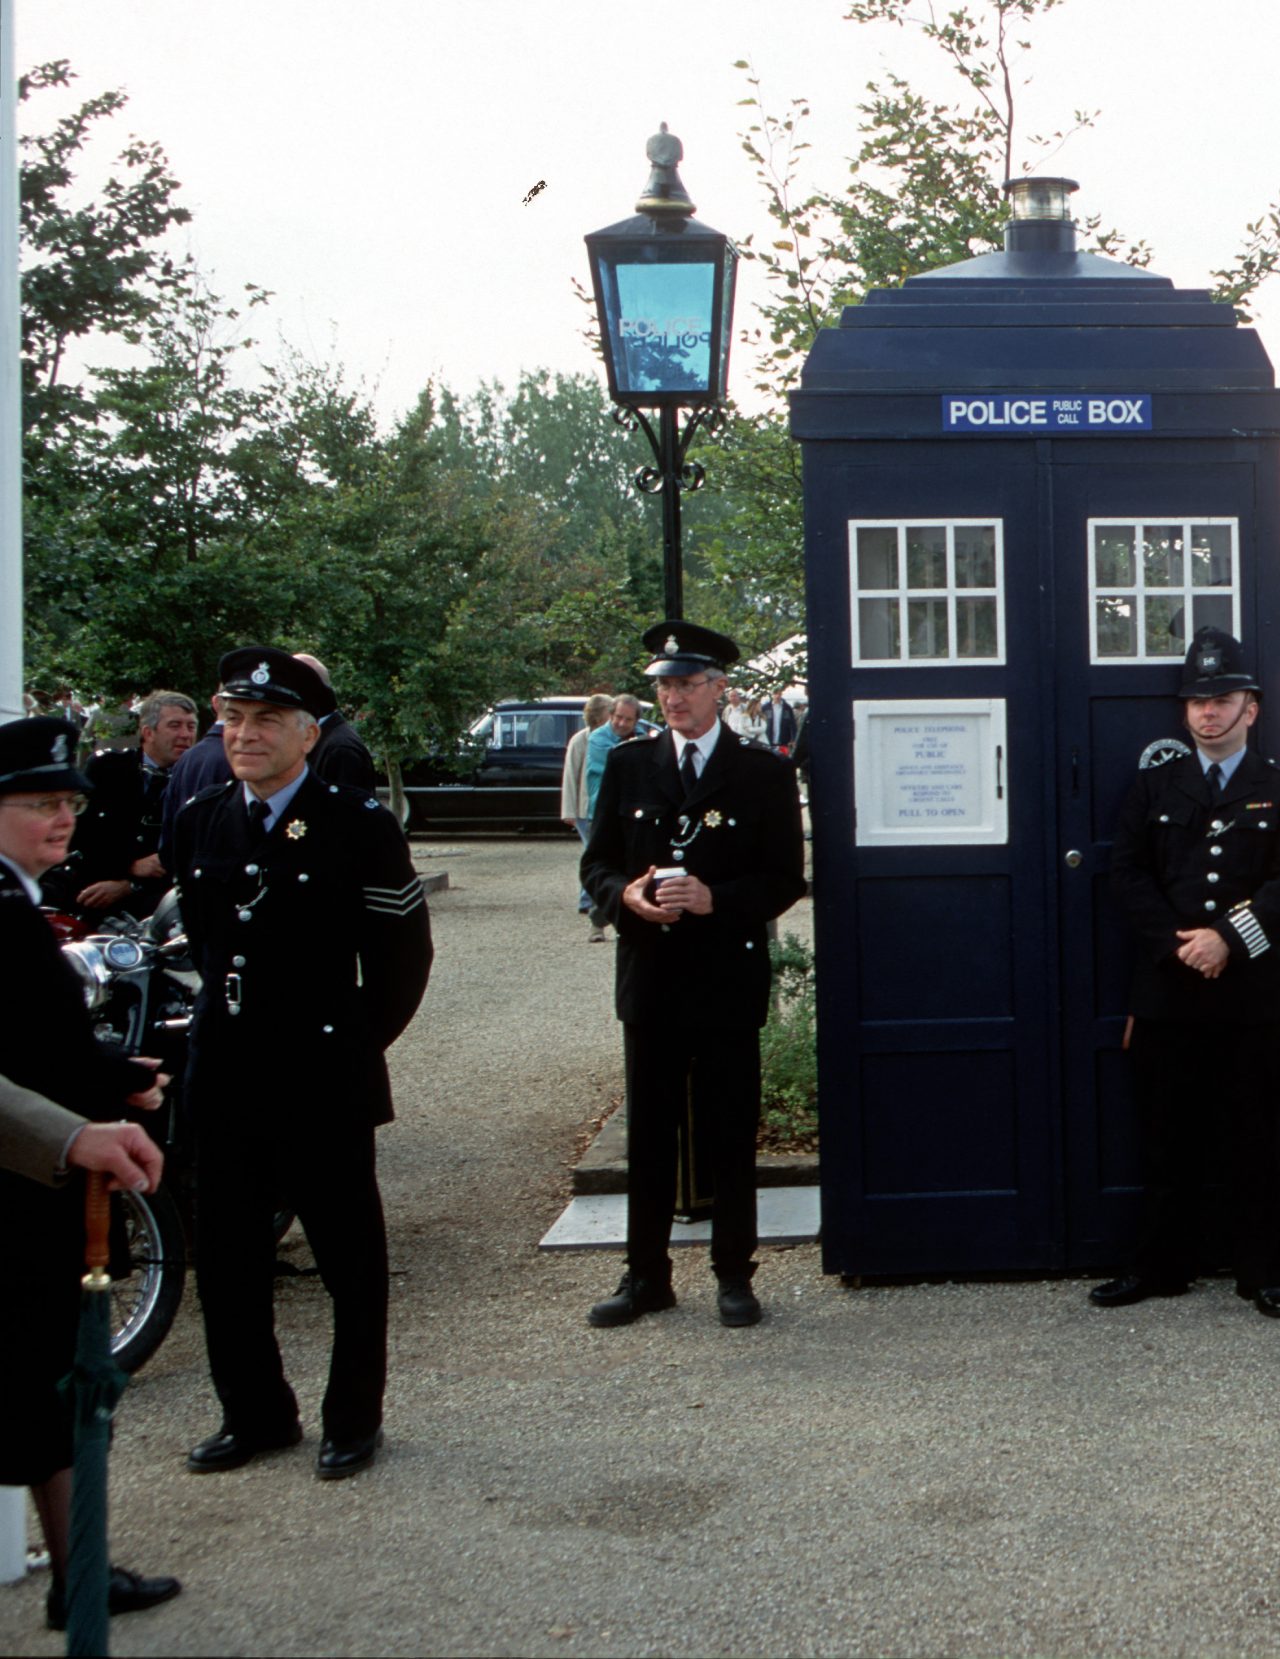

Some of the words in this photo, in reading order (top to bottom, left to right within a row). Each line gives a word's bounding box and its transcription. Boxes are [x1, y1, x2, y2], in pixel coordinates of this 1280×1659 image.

[619, 318, 703, 337] POLICE
[950, 401, 1047, 424] POLICE
[1053, 401, 1081, 411] PUBLIC
[1088, 400, 1143, 423] BOX
[1057, 413, 1078, 424] CALL
[941, 808, 965, 816] OPEN
